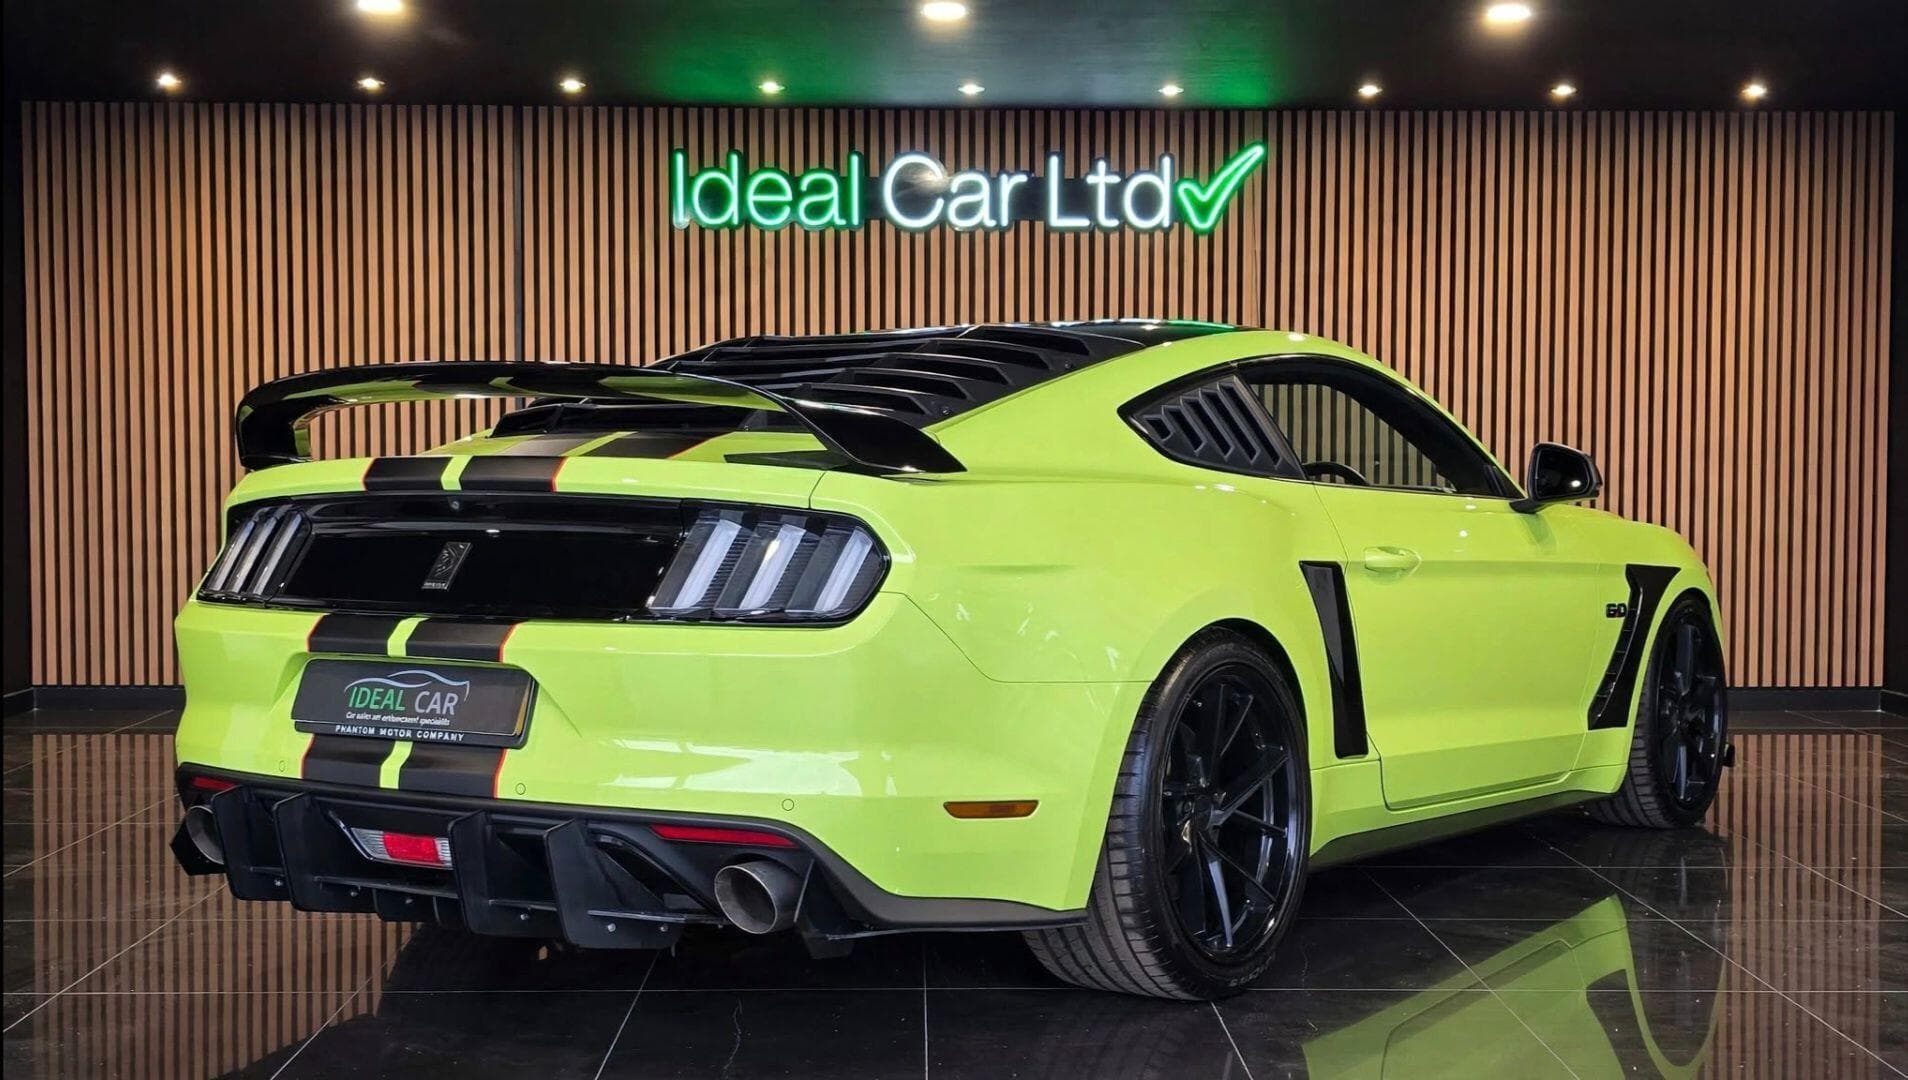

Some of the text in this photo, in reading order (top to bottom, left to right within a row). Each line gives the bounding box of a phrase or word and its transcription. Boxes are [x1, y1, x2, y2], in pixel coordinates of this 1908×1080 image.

[672, 150, 1174, 230] Ideal Car Ltd
[348, 686, 459, 715] IDEAL CAR
[335, 724, 464, 741] PHANTOM MOTOR COMPANY
